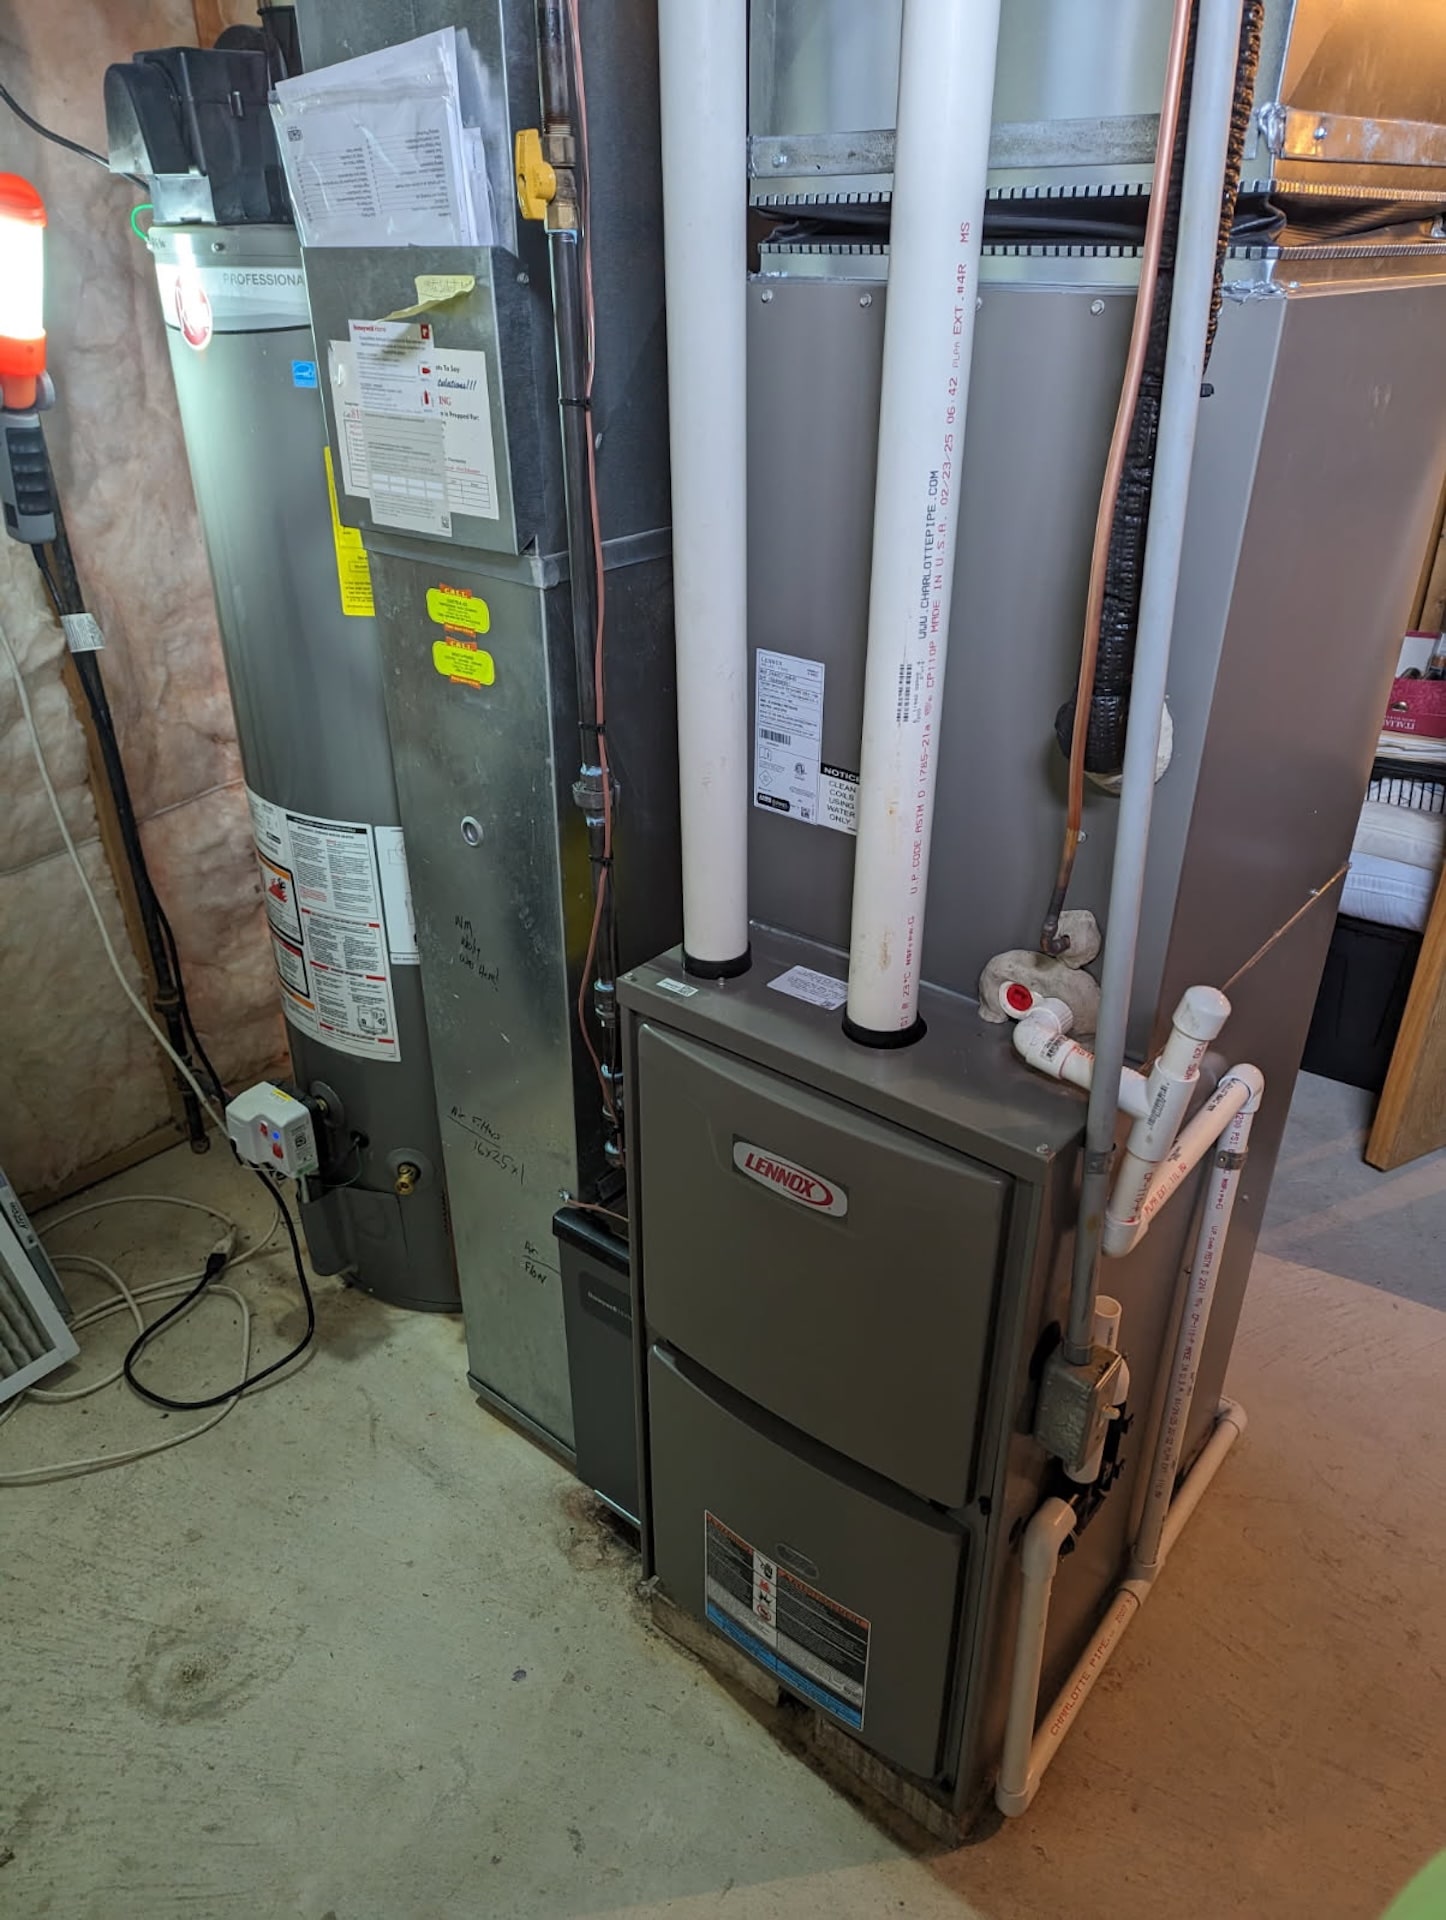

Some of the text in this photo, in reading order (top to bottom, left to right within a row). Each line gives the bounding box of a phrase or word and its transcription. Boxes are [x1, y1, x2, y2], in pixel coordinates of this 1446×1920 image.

[960, 222, 970, 243] MS
[934, 575, 944, 590] IN
[930, 600, 941, 633] MADE
[829, 780, 856, 793] CLEAN
[829, 789, 855, 802] COILS
[917, 790, 926, 799] D
[827, 803, 856, 818] WATER
[828, 797, 855, 810] USING
[915, 804, 924, 833] ASTM
[744, 1152, 816, 1198] LENNOX
[1050, 1671, 1091, 1736] CHARLOTTE
